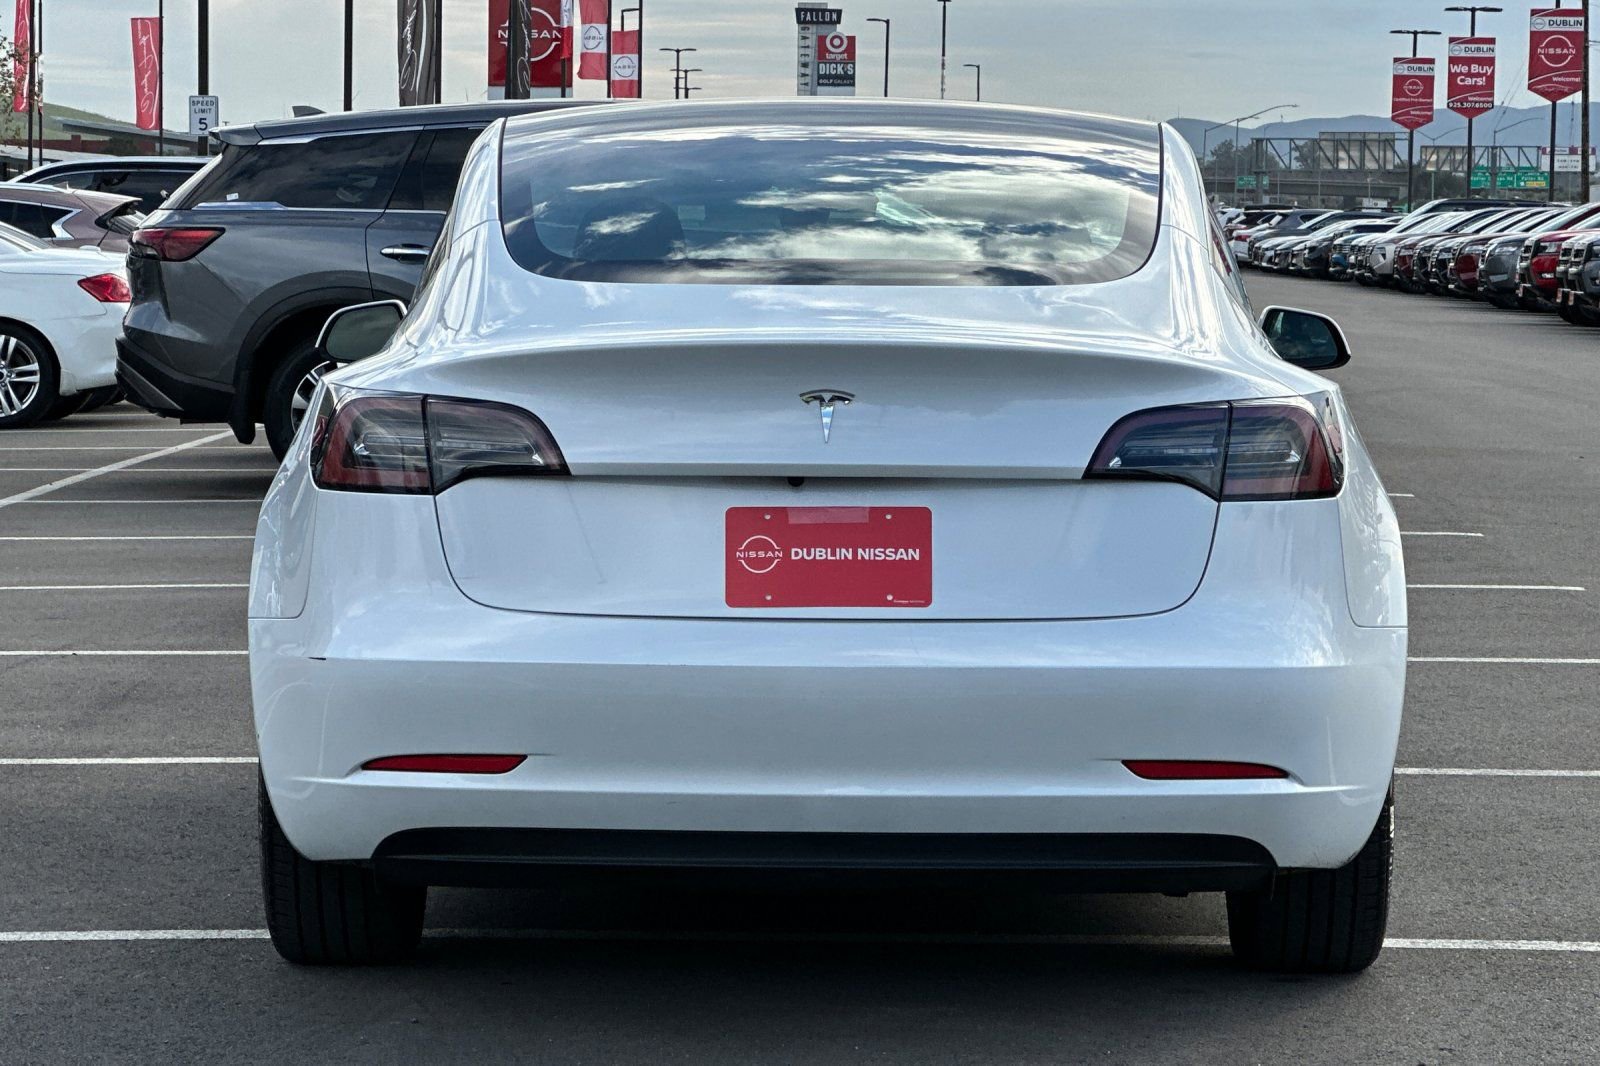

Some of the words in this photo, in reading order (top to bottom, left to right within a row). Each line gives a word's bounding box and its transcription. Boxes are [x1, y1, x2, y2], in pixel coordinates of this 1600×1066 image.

[800, 11, 837, 22] FALLON
[1548, 19, 1582, 27] DUBLIN
[498, 29, 562, 39] NSAN
[825, 52, 848, 61] target
[819, 63, 854, 75] DICK'S
[1450, 63, 1469, 73] We
[1470, 64, 1493, 76] Buy
[1456, 76, 1486, 86] Cars!
[198, 117, 208, 131] 5
[790, 548, 853, 561] DUBLIN
[857, 548, 920, 561] NISSAN
